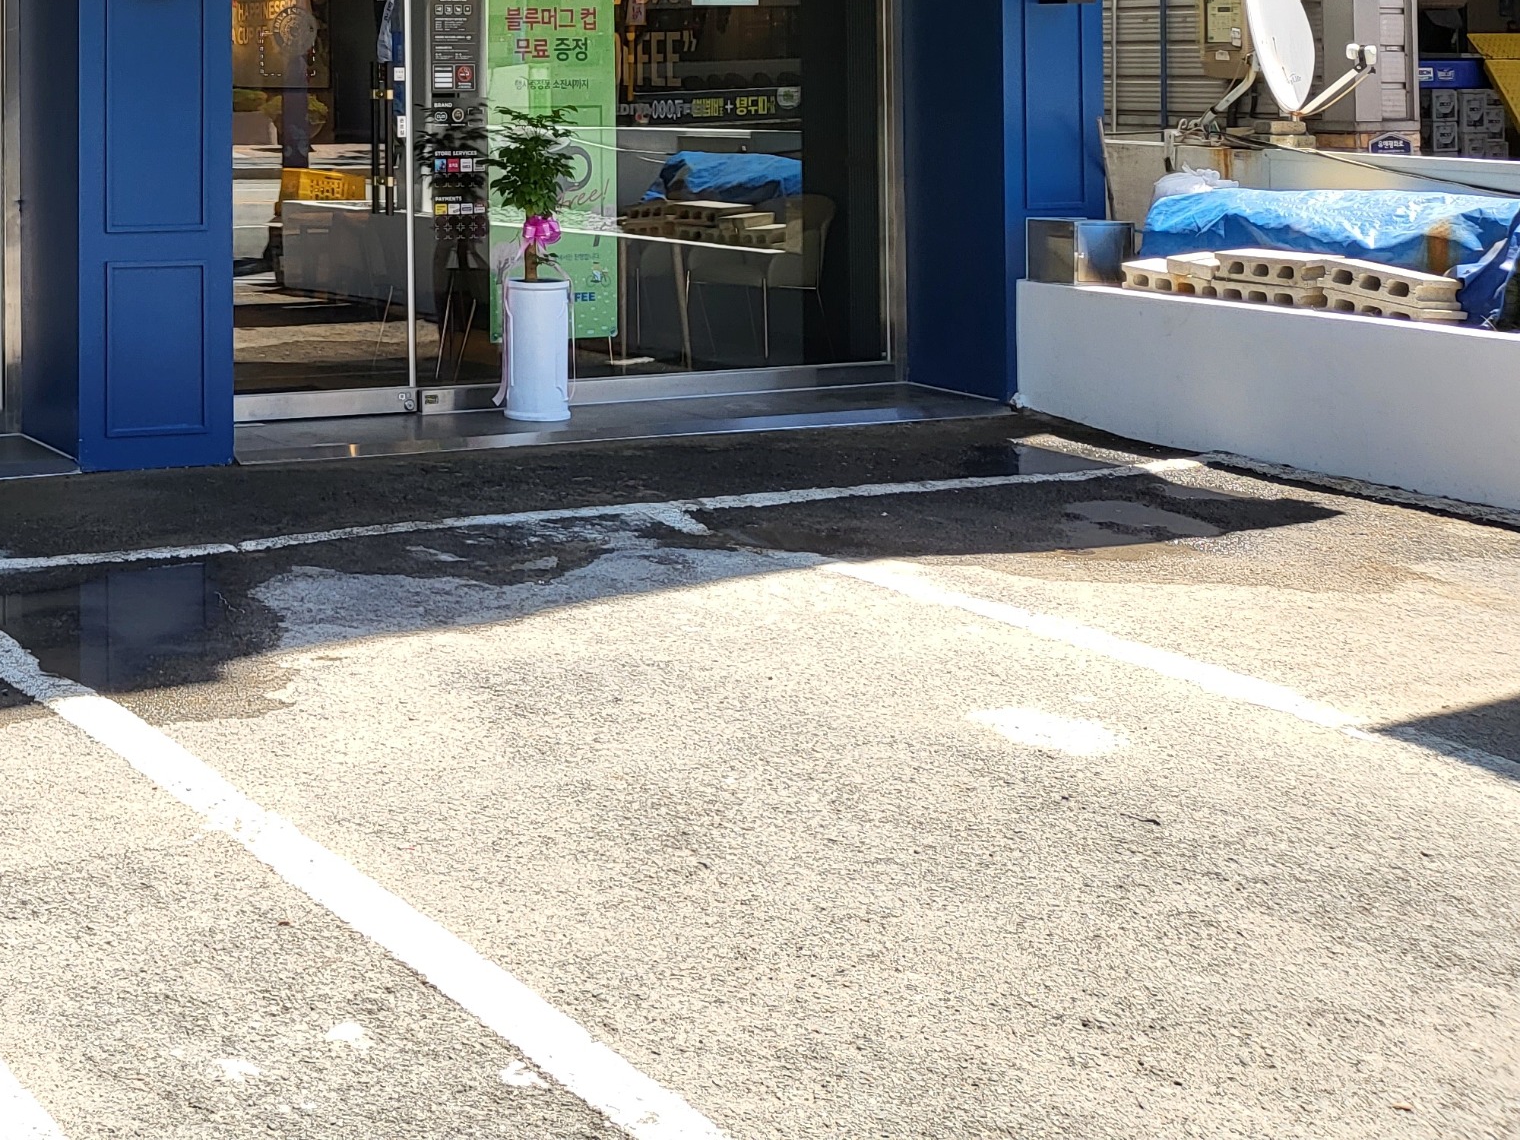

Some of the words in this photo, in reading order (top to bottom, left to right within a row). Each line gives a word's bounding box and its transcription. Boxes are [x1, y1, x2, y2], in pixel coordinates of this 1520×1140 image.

[505, 7, 576, 31] 블루머그
[580, 7, 597, 31] 컵
[514, 37, 551, 60] 무료
[553, 37, 589, 61] 증정
